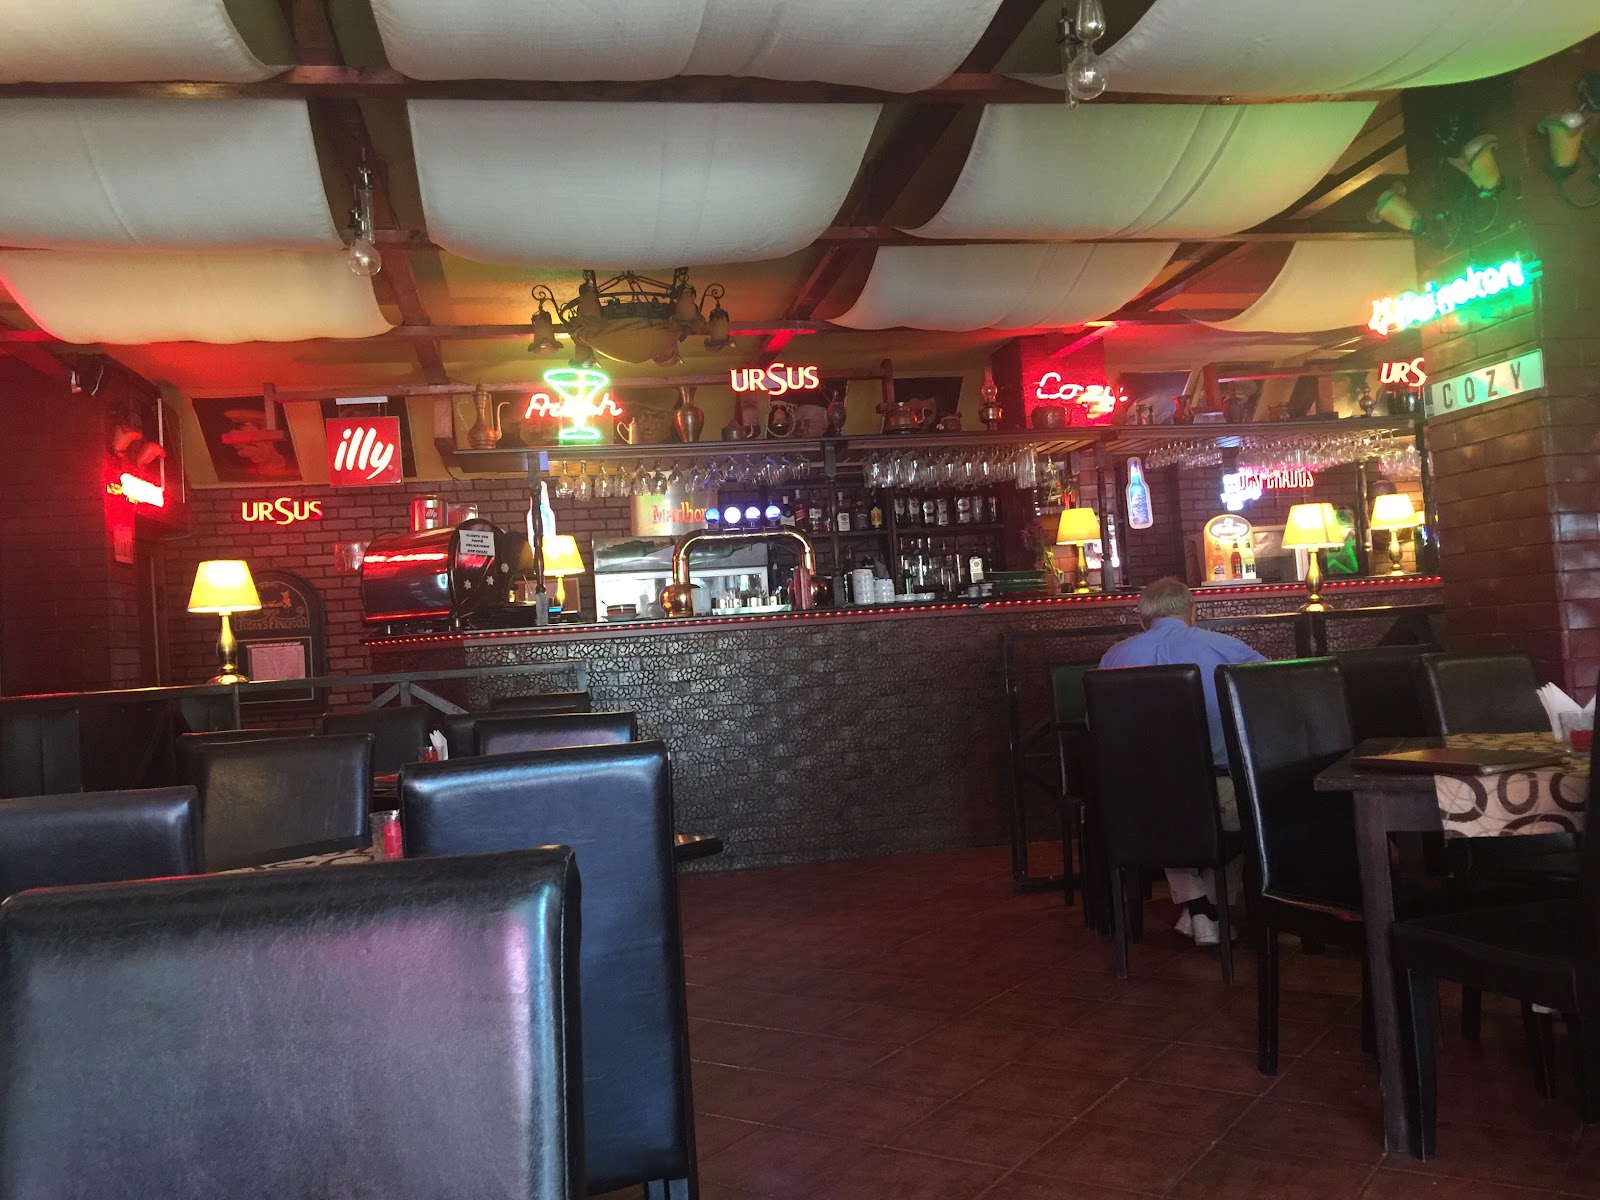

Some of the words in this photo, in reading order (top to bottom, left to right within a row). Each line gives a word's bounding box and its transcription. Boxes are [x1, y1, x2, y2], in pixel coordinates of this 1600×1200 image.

[730, 362, 820, 396] URSUS
[1443, 361, 1521, 410] COZY
[334, 426, 395, 480] illy
[241, 497, 323, 525] URSUS
